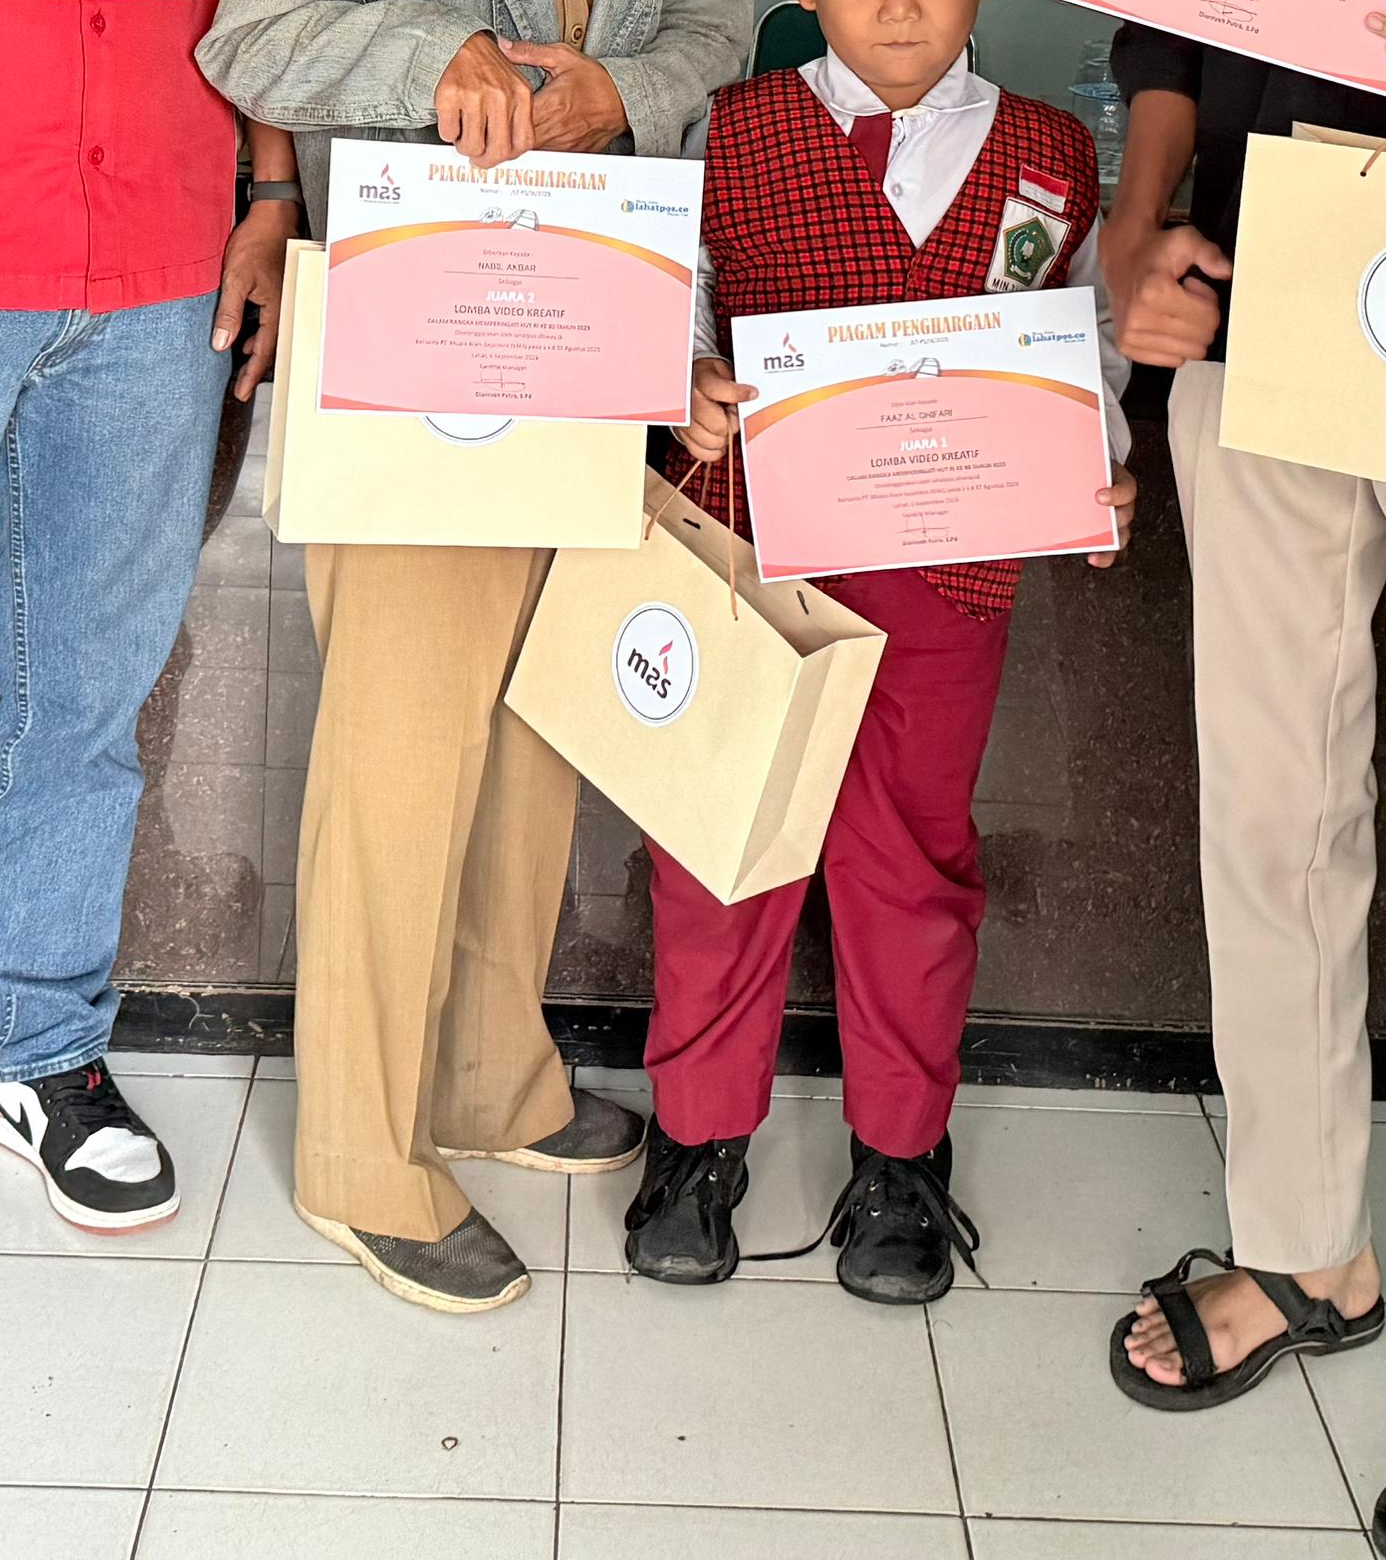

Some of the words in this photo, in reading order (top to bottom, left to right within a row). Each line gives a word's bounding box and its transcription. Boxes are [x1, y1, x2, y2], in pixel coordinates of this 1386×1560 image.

[428, 163, 488, 184] PIAGAM
[493, 167, 607, 191] PENGHARGAAN
[357, 183, 401, 200] mas
[506, 262, 536, 272] AKBAR
[485, 289, 525, 303] JUARA
[527, 291, 536, 304] 2
[453, 304, 491, 315] LOMBA
[492, 305, 525, 317] VIDEO
[526, 307, 565, 318] KREATIF
[826, 321, 887, 344] PIAGAM
[890, 310, 1002, 338] PENGHARGAAN
[762, 352, 805, 370] mas
[899, 437, 938, 452] JUARA
[939, 436, 949, 448] 1
[870, 455, 907, 468] LOMBA
[908, 452, 939, 464] VIDEO
[940, 448, 980, 461] KREATIF
[627, 647, 671, 699] mas
